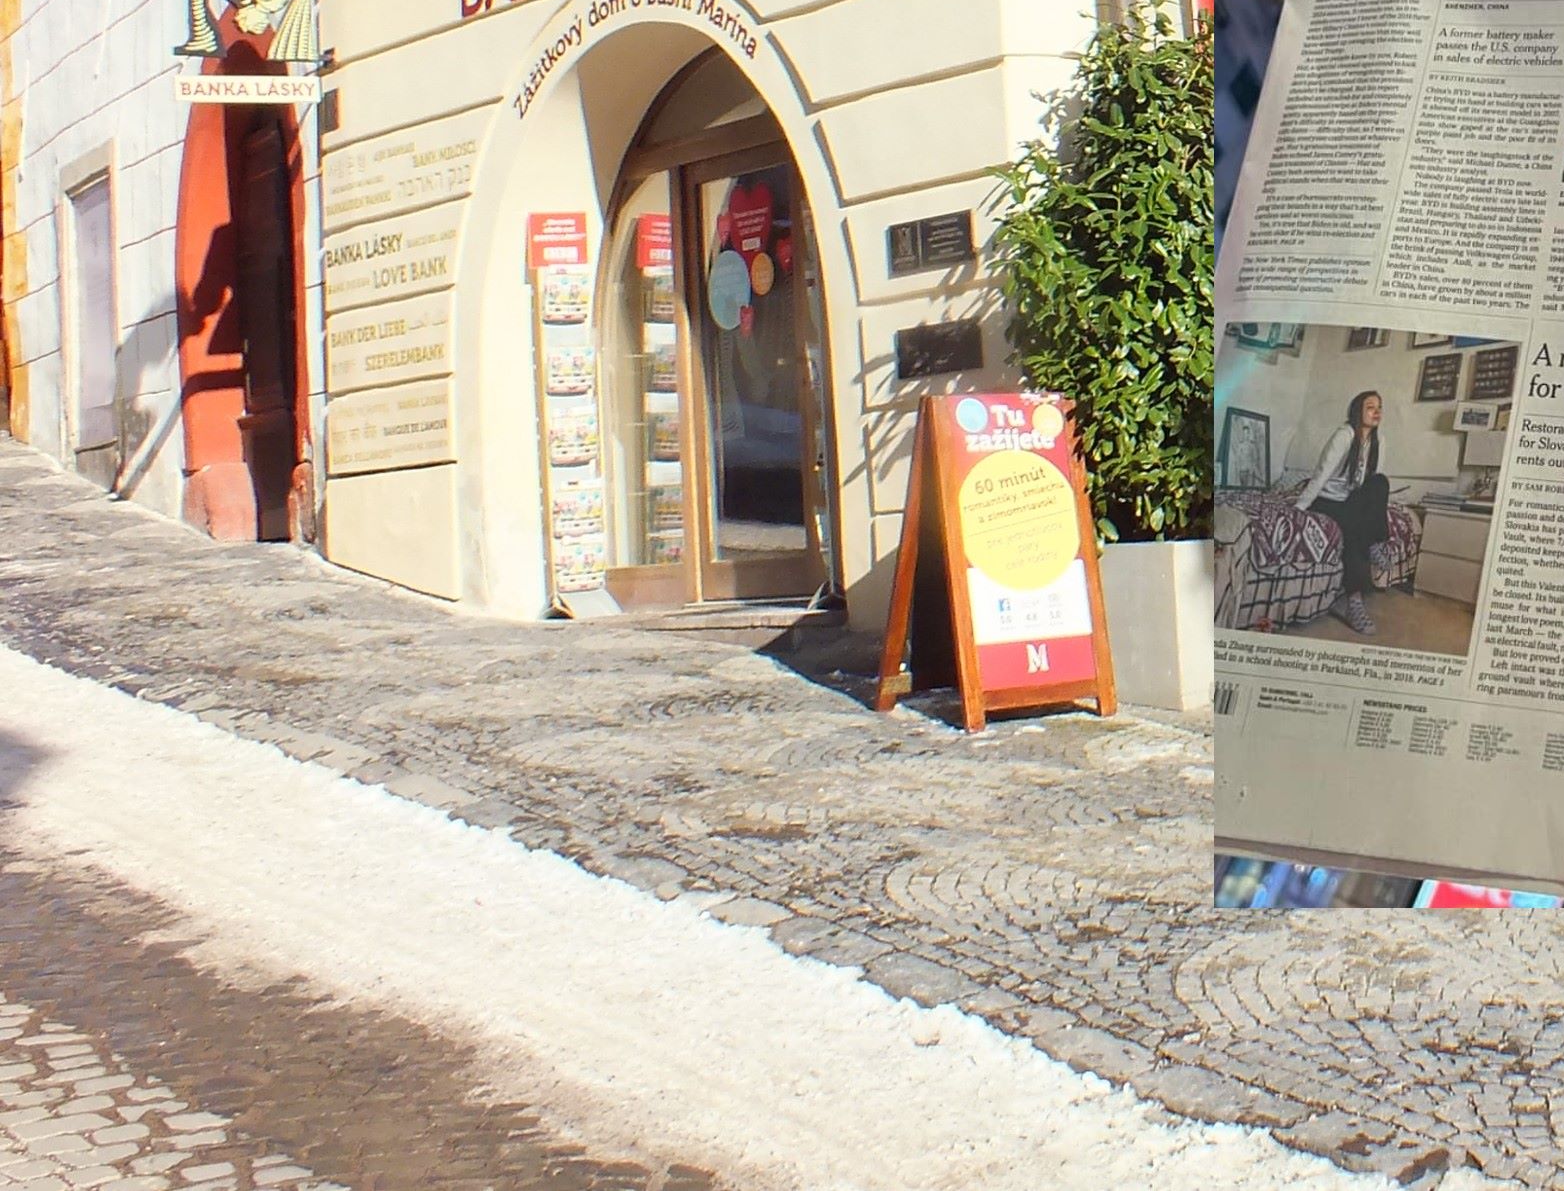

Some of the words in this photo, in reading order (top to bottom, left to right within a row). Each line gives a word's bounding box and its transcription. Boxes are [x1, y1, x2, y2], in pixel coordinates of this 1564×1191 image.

[1438, 27, 1449, 40] A
[1450, 27, 1484, 40] former
[1486, 28, 1520, 42] battery
[1523, 28, 1554, 41] maker
[1433, 53, 1444, 64] in
[1446, 53, 1469, 64] sales
[1472, 54, 1485, 66] of
[1486, 55, 1521, 67] electric
[1524, 55, 1563, 67] vehicles
[1435, 43, 1469, 55] passes
[1471, 41, 1488, 53] the
[1490, 42, 1510, 54] U.S.
[1513, 44, 1559, 57] company
[513, 14, 584, 119] Zážitkový
[181, 83, 249, 97] BANKA
[254, 80, 316, 97] LÁSKY
[327, 243, 363, 268] BANKA
[365, 232, 403, 260] LÁSKY
[373, 263, 408, 289] LOVE
[411, 256, 447, 281] BANK
[331, 329, 357, 349] BANK
[358, 323, 376, 343] DER
[1532, 343, 1552, 367] A
[1528, 374, 1561, 399] for
[990, 404, 1025, 427] Tu
[965, 427, 1056, 454] zažijete
[1518, 435, 1536, 450] for
[1516, 454, 1546, 468] rents
[1000, 466, 1047, 490] minút
[1511, 482, 1524, 492] BY
[1525, 483, 1543, 494] SAM
